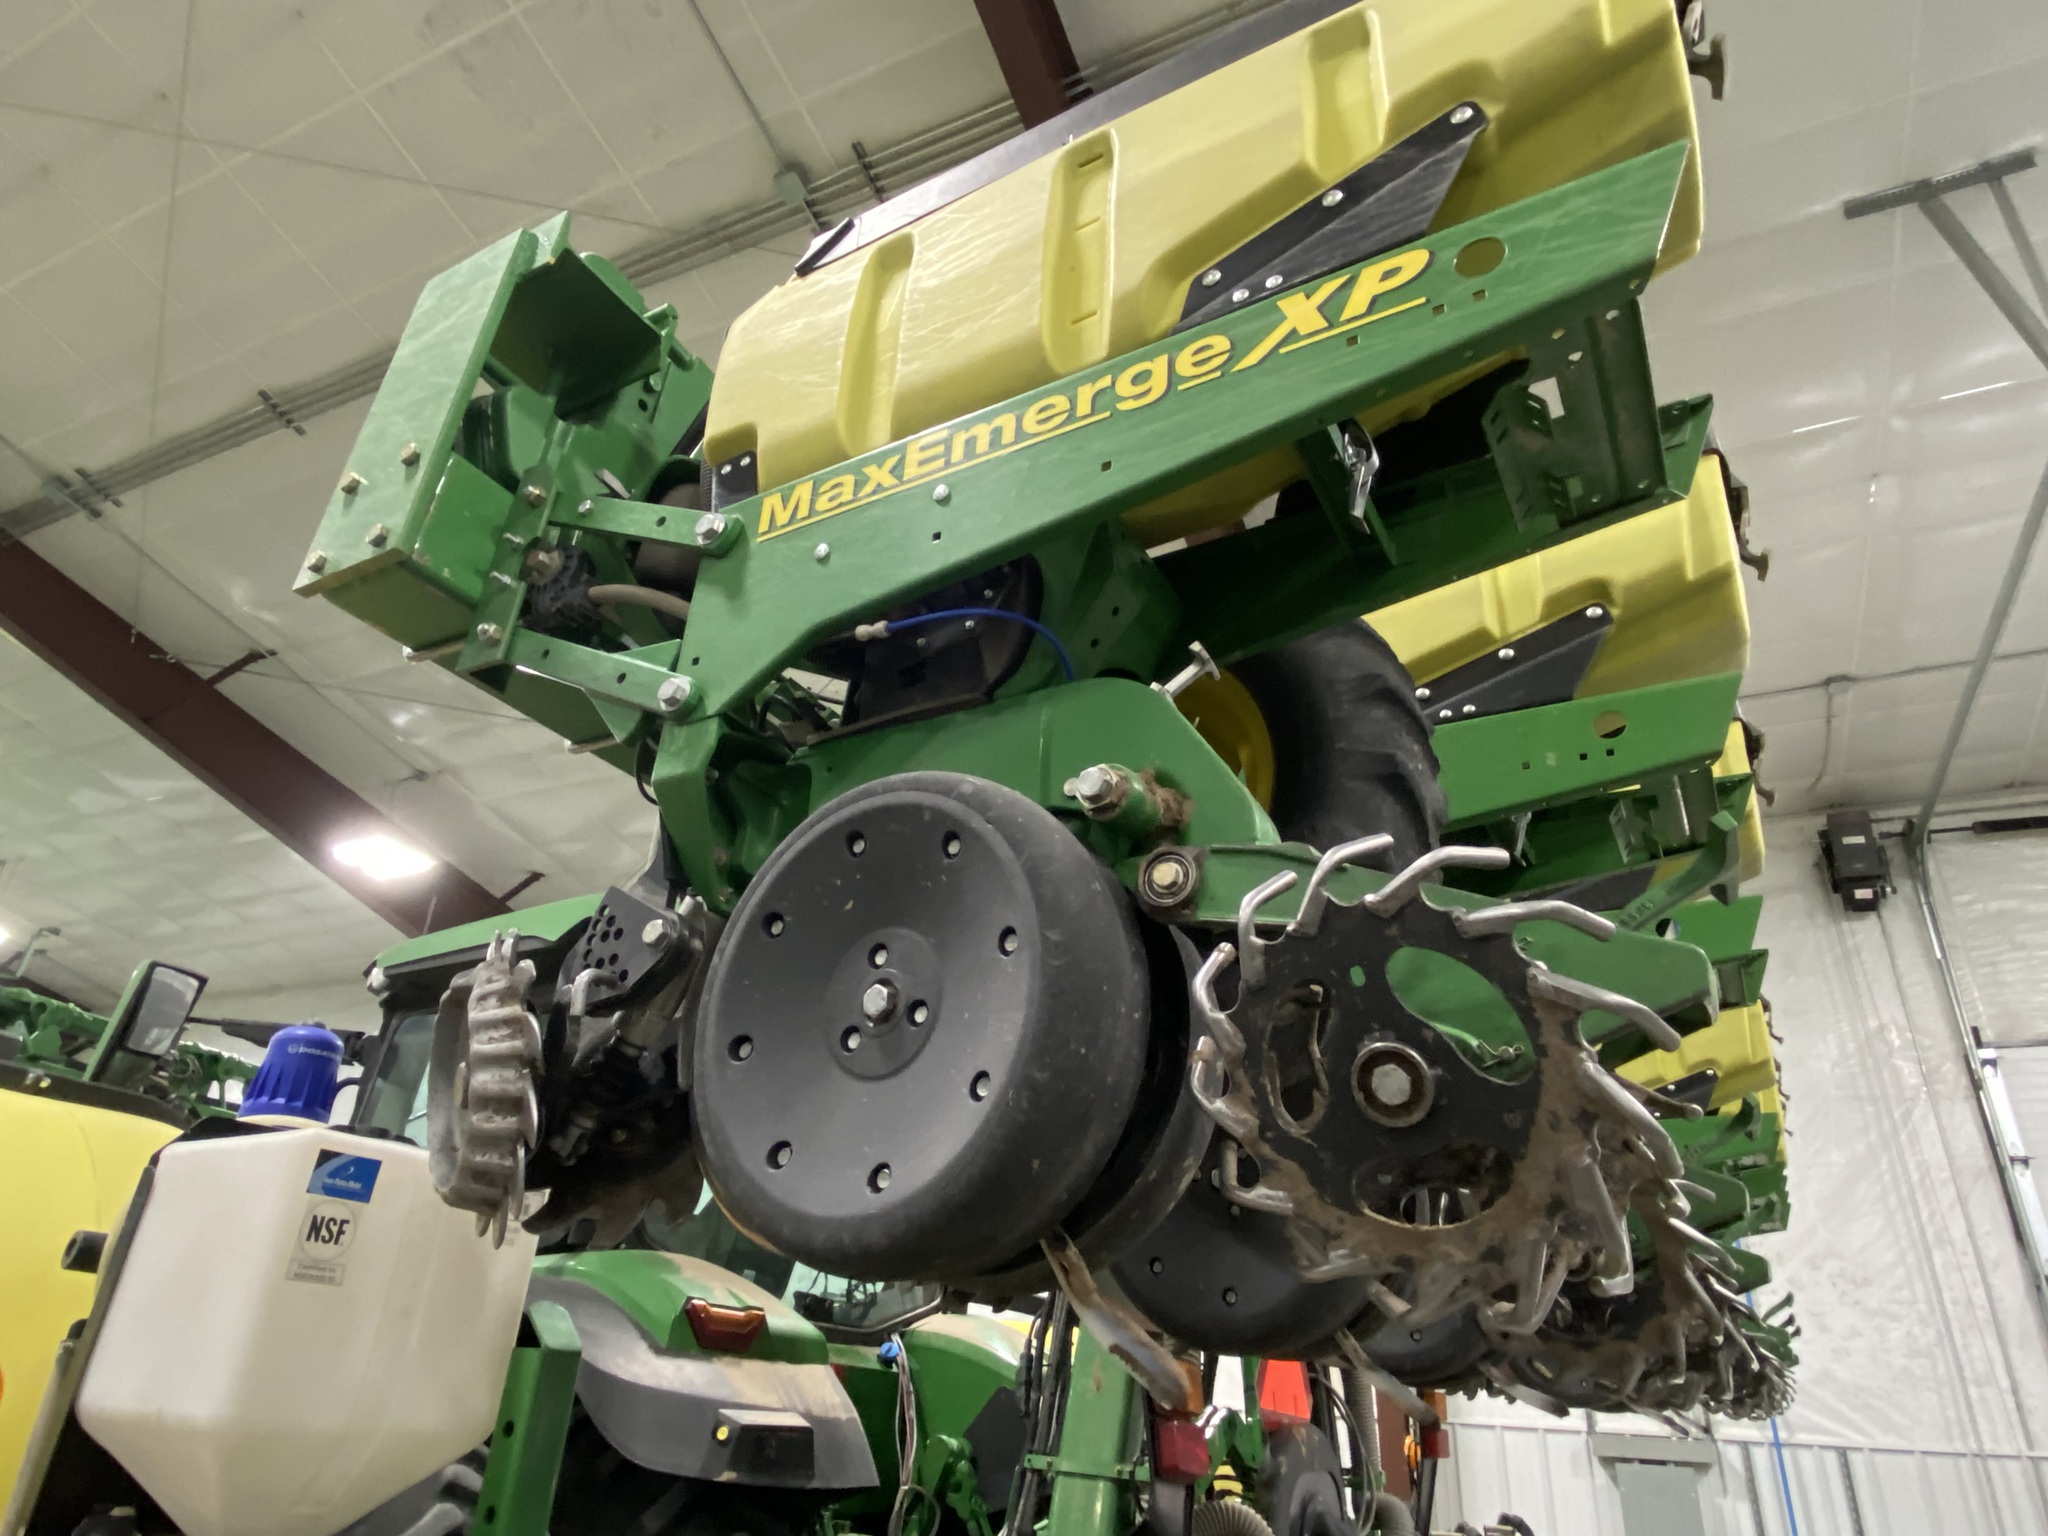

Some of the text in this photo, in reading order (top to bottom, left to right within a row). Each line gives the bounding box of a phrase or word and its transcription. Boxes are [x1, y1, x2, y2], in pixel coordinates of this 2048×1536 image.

[757, 248, 1433, 534] MaxEmerge XP
[305, 1214, 350, 1246] NSF
